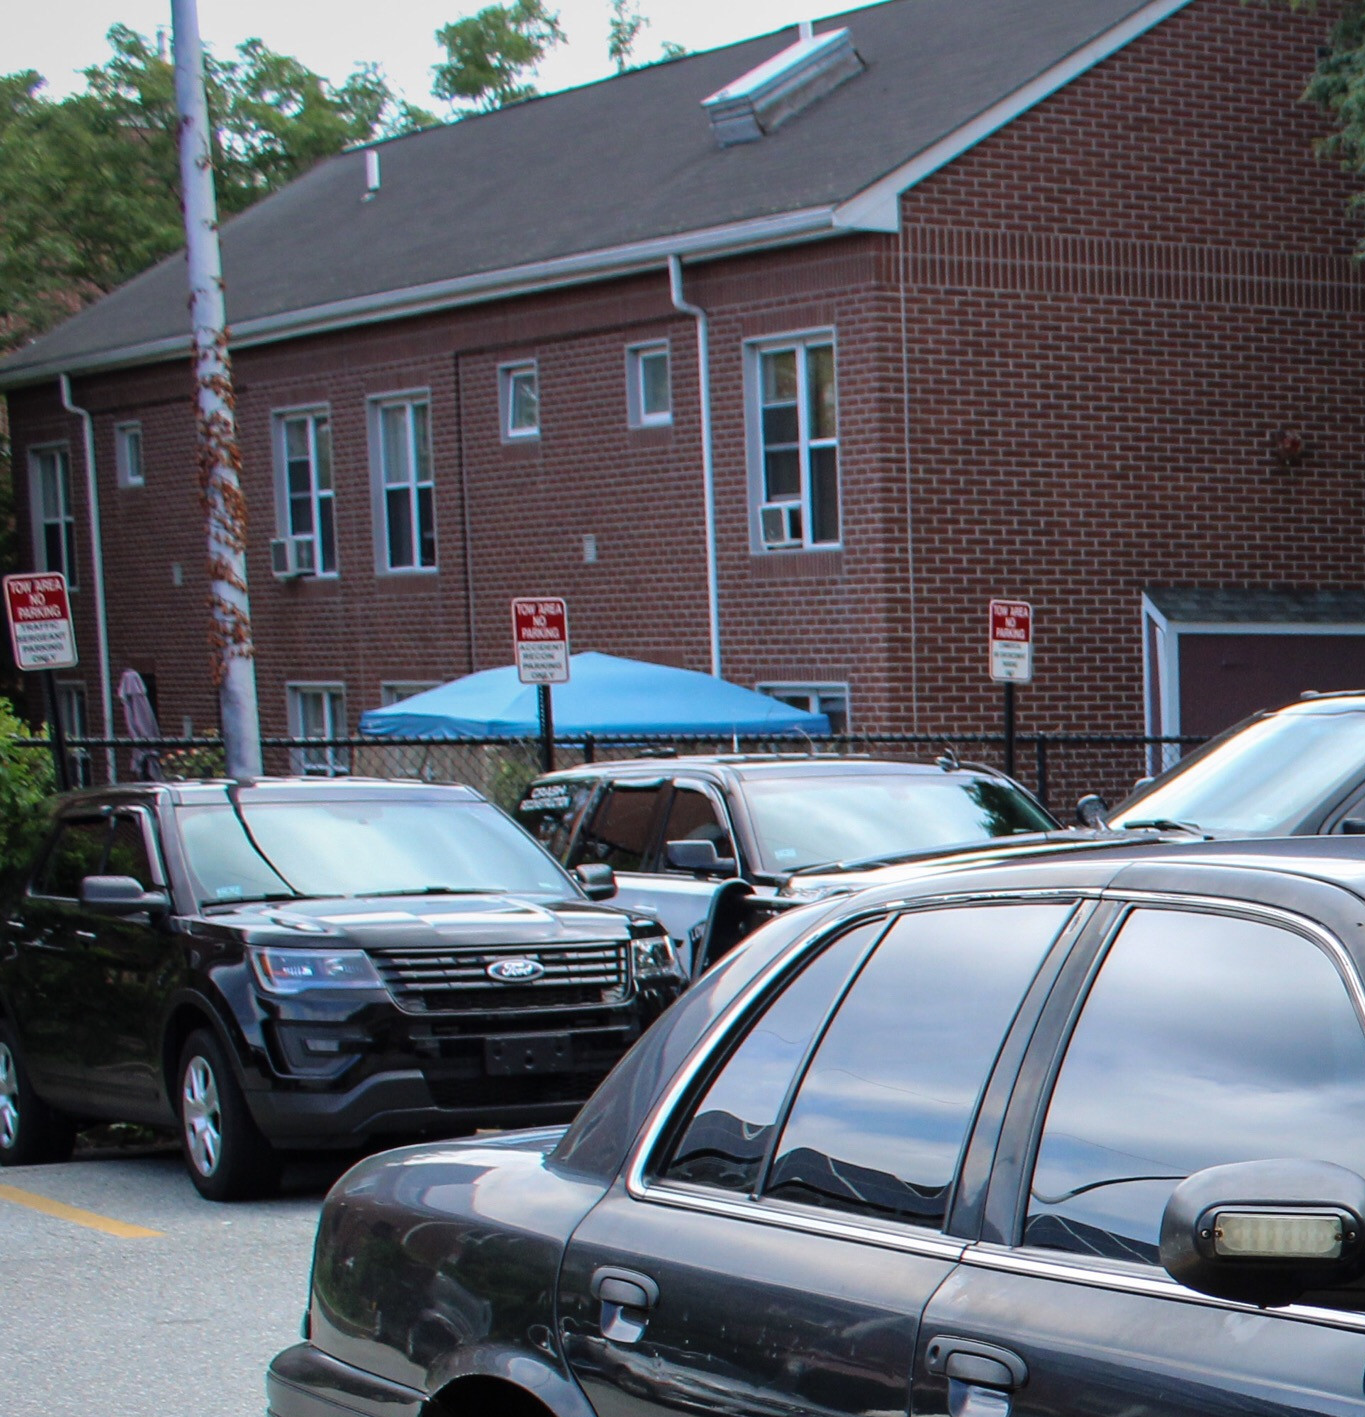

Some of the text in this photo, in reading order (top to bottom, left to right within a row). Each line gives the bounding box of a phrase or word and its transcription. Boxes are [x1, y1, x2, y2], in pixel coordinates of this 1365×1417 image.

[8, 578, 63, 595] TOW AREA
[28, 593, 46, 605] NO
[17, 605, 62, 620] PARKING
[516, 602, 563, 616] TOW AREA
[993, 605, 1028, 617] TOW AREA
[20, 622, 60, 631] TRAFFIC
[532, 615, 547, 627] NO
[1005, 617, 1016, 627] NO
[521, 627, 560, 639] PARKING
[996, 628, 1026, 640] PARKING
[22, 642, 64, 653] PARKING
[32, 654, 56, 663] ONLY
[501, 961, 533, 977] Ford
